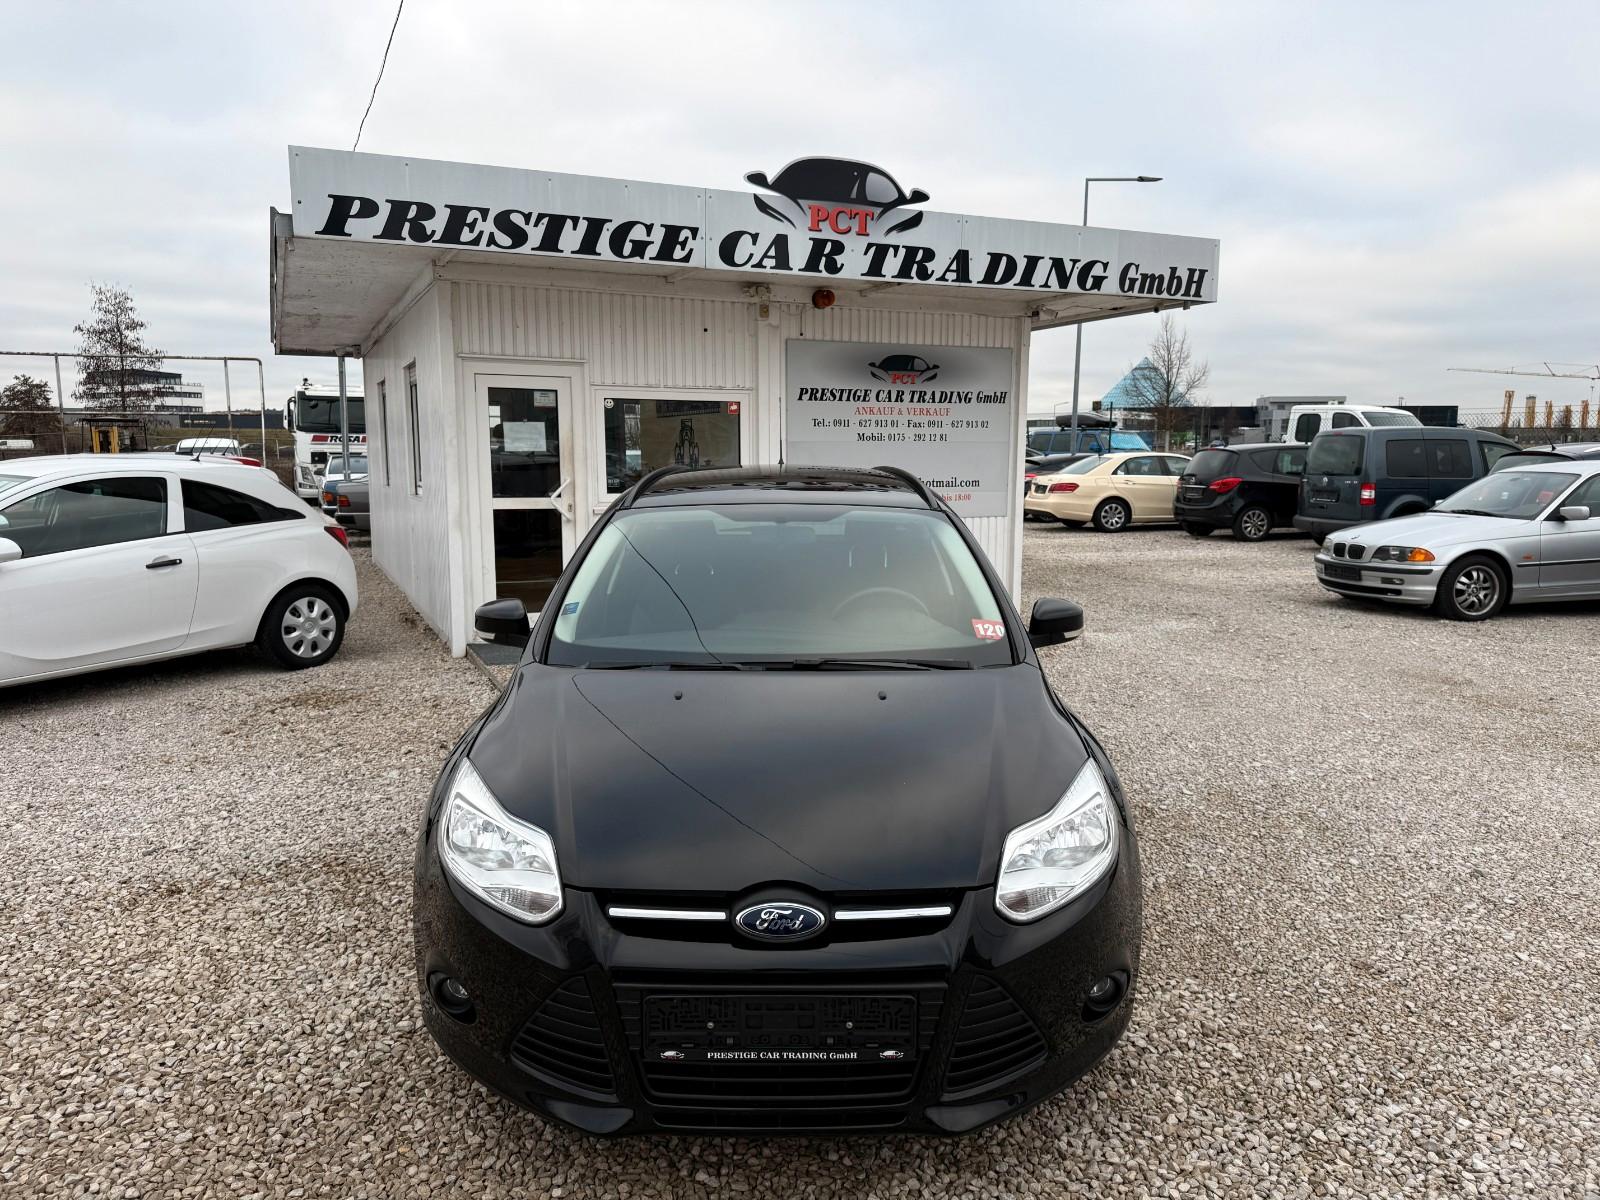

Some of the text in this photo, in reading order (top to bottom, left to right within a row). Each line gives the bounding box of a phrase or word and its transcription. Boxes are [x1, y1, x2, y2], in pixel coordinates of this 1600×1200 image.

[808, 204, 875, 236] PCT
[314, 193, 1209, 298] PRESTIGE CAR TRADING GmbH
[890, 373, 917, 385] PCT
[797, 387, 1008, 404] PRESTIGE CAR TRADING GmbH
[854, 406, 951, 416] ANKAUF & VERKAUF
[812, 418, 831, 428] Tel.:
[833, 419, 850, 428] 0911
[858, 419, 872, 428] 627
[874, 419, 888, 428] 913
[890, 419, 899, 428] 01
[907, 419, 925, 428] Fax:
[927, 420, 943, 428] 0911
[951, 420, 964, 428] 627
[966, 420, 979, 429] 913
[981, 420, 989, 429] 02
[856, 433, 886, 442] Mobil:
[888, 433, 906, 442] 0175
[913, 433, 926, 442] 292
[929, 433, 938, 442] 12
[939, 433, 948, 442] 81
[975, 623, 1005, 637] 120
[756, 908, 804, 930] Ford
[707, 1051, 758, 1059] PRESTIGE
[760, 1051, 780, 1059] CAR
